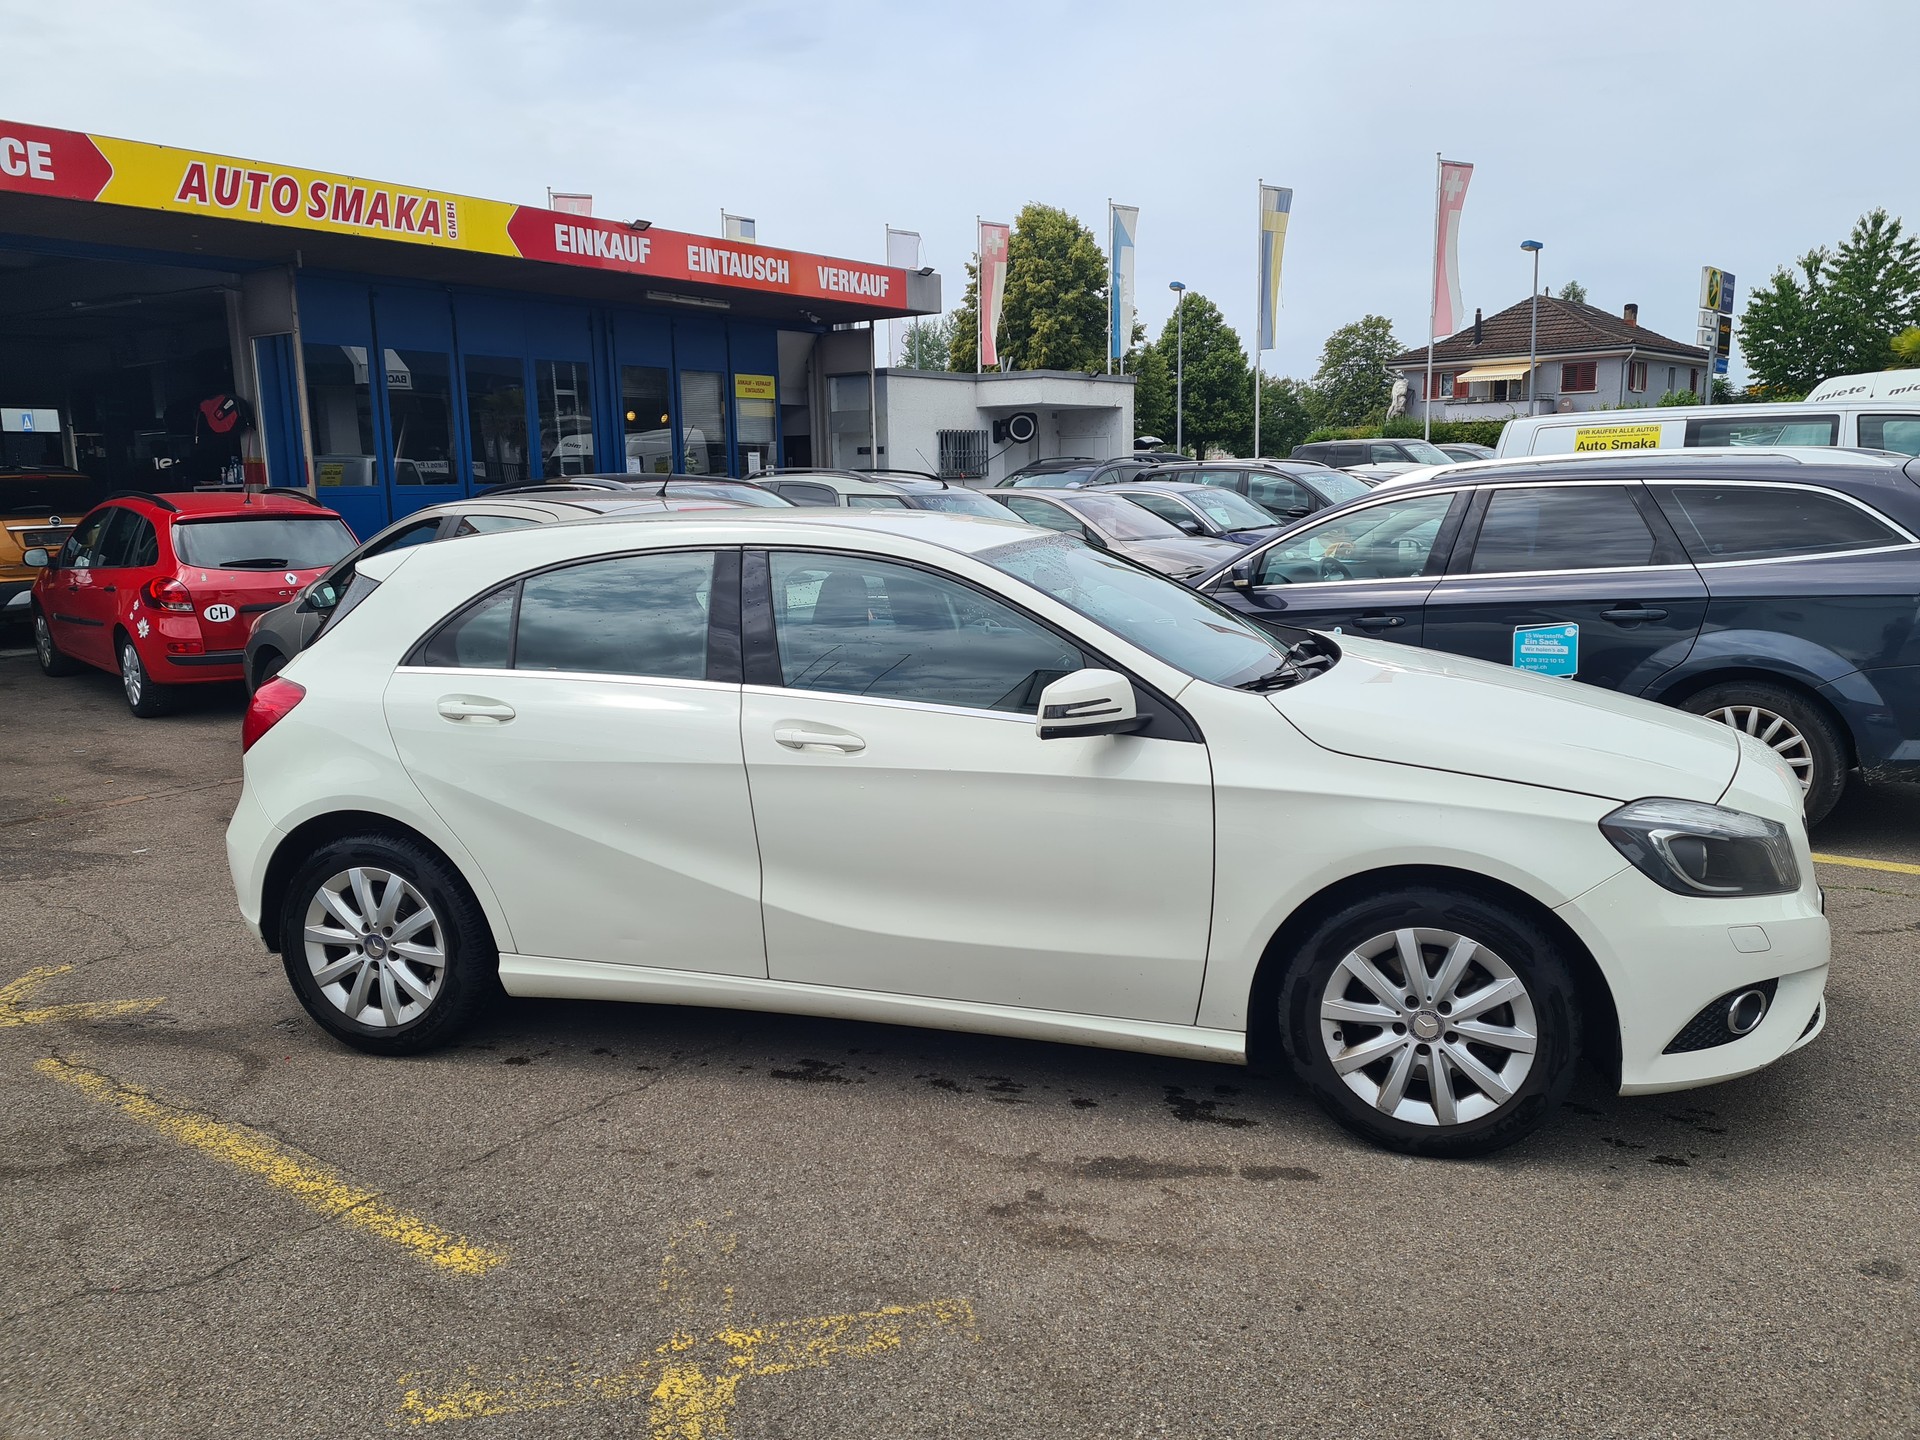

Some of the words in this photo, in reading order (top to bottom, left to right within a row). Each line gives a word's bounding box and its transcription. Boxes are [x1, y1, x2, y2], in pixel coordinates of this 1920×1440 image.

[175, 161, 301, 216] AUTO
[306, 180, 442, 237] SMAKA
[447, 201, 457, 239] GMBH
[554, 223, 650, 264] EINKAUF
[687, 245, 789, 284] EINTAUSCH
[817, 265, 889, 298] VERKAUF
[1814, 386, 1866, 402] miete
[1577, 441, 1607, 451] Auto
[1611, 438, 1656, 450] Smaka
[209, 606, 229, 620] CH
[1539, 638, 1561, 646] Sack.
